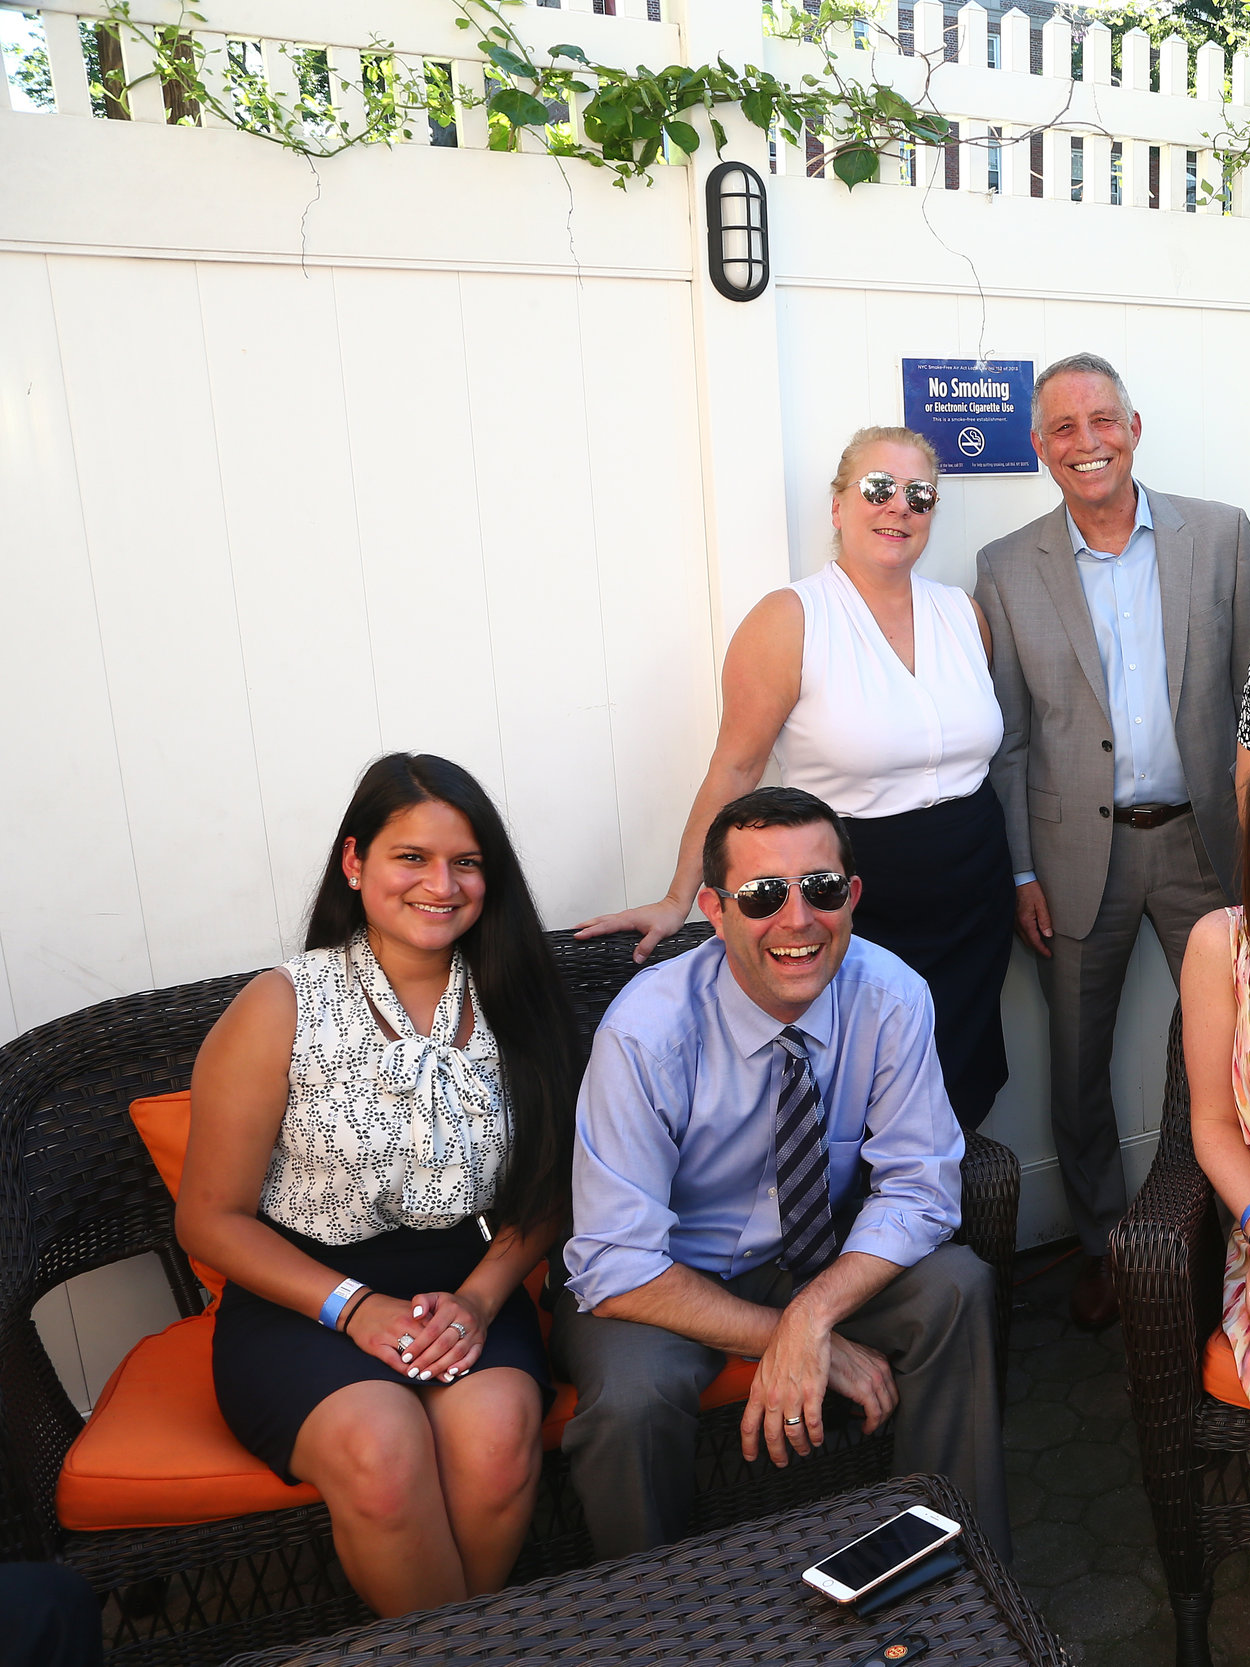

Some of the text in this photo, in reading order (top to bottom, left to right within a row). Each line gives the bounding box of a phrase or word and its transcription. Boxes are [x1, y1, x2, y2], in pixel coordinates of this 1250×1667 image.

[928, 377, 1010, 401] No Smoking
[925, 401, 1014, 414] or Electronic Cigarette Use
